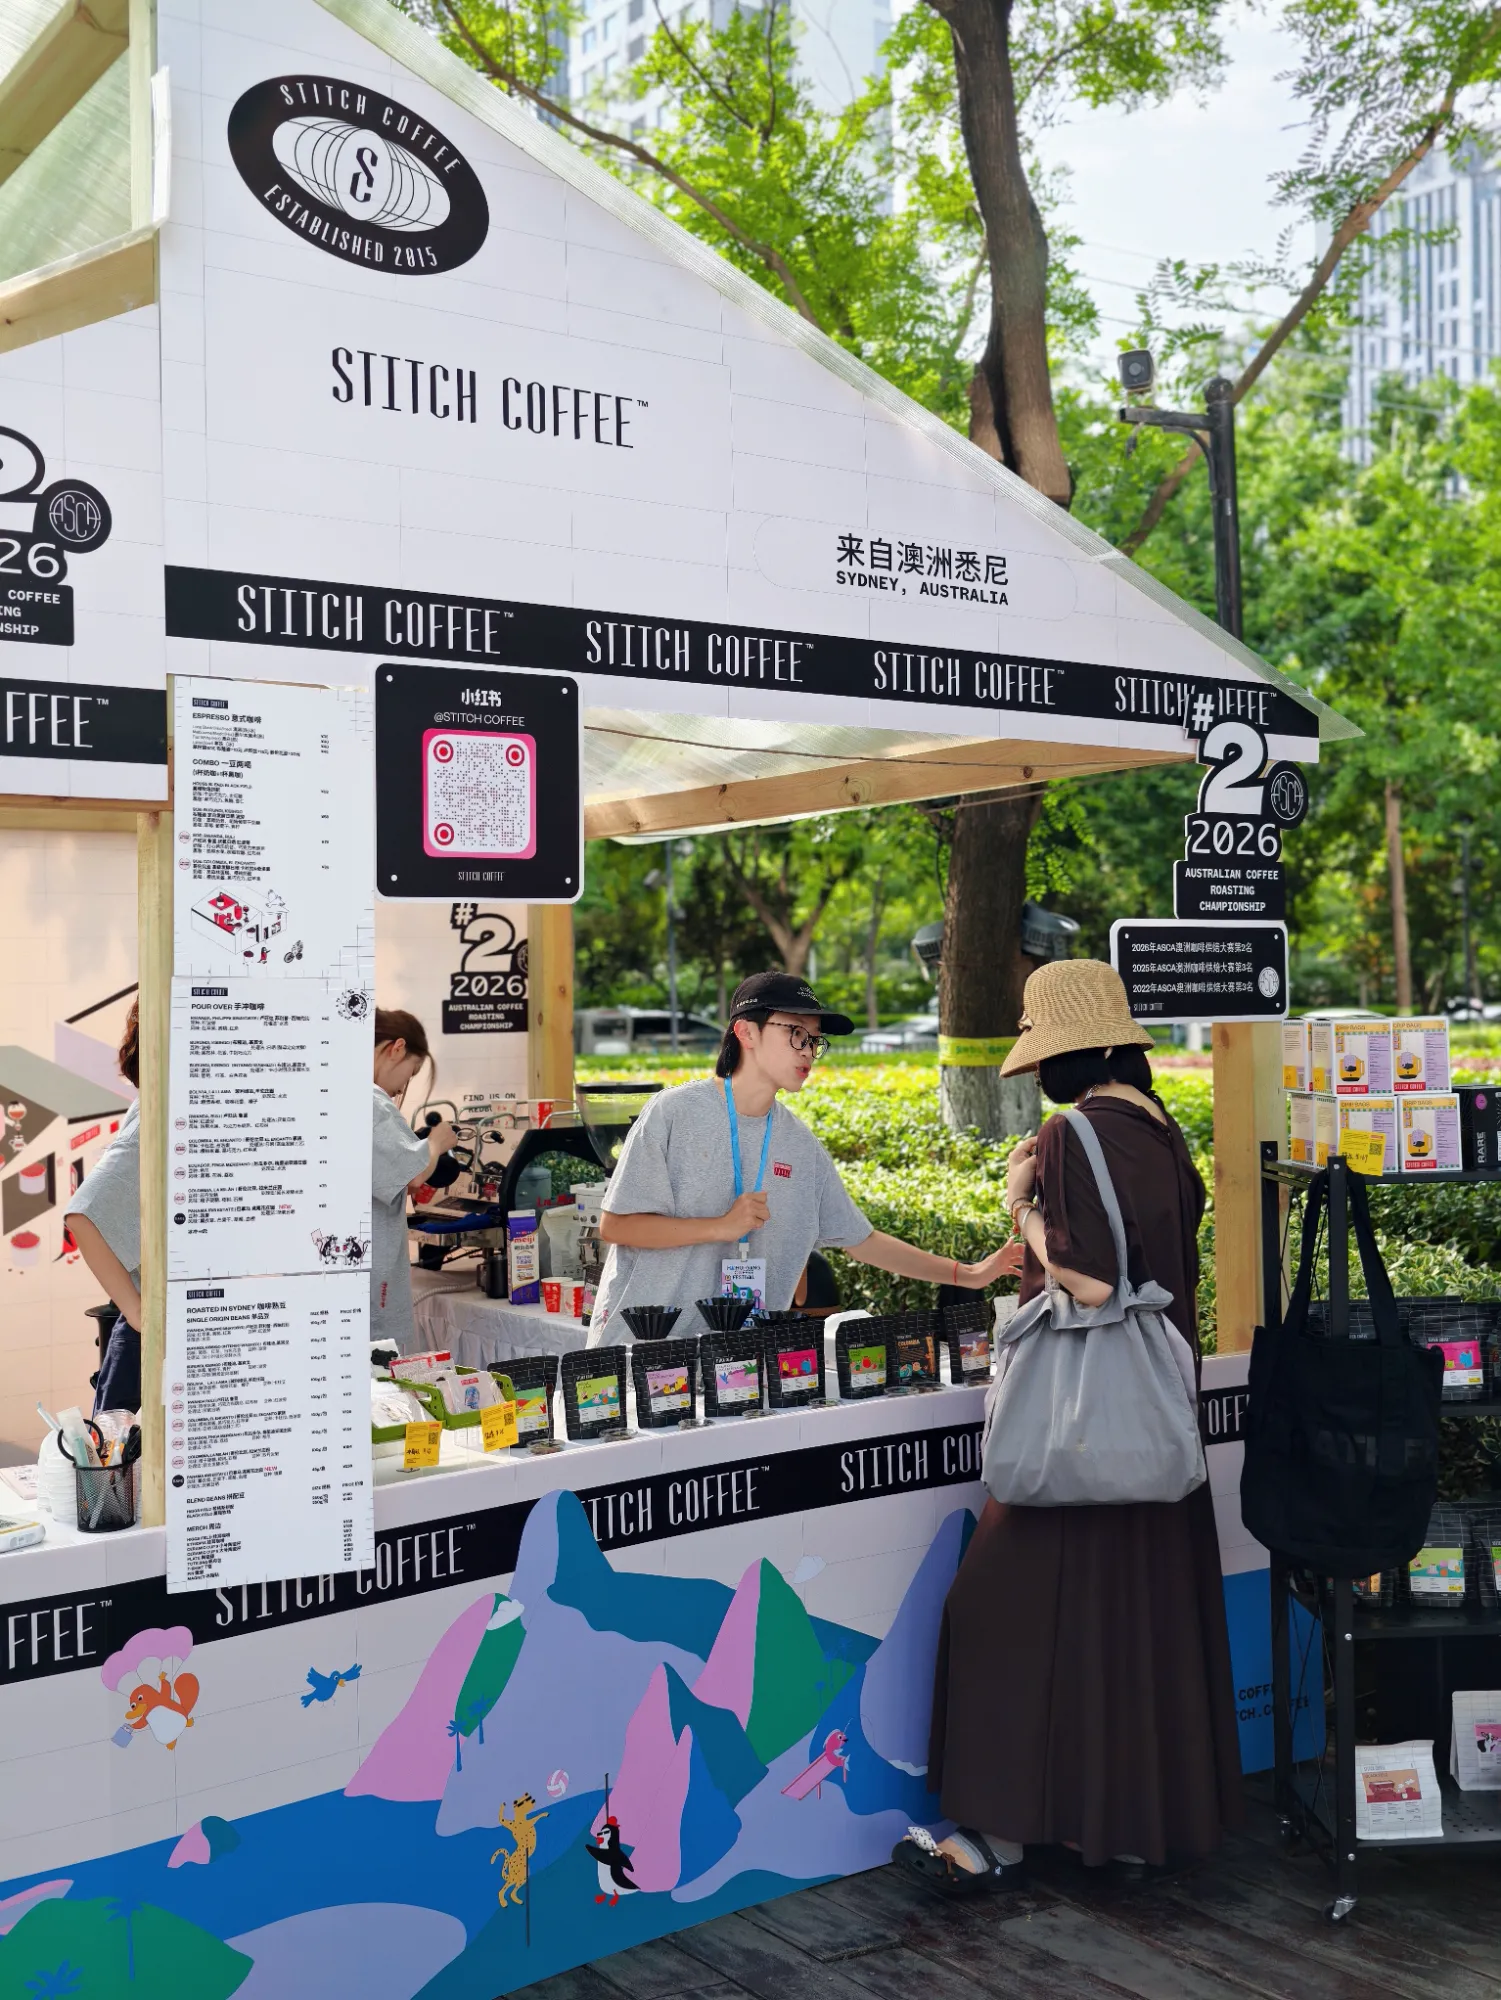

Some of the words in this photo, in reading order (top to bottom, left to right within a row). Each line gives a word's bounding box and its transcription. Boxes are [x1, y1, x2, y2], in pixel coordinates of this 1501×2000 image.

[280, 83, 366, 115] STITCH
[383, 106, 463, 175] COFFEE
[263, 184, 384, 264] ESTABLISHED
[394, 246, 439, 268] 2015
[332, 347, 477, 423] STITCH
[0, 538, 60, 578] 26
[836, 533, 1009, 586] 来自澳洲悉尼
[8, 590, 61, 605] COFFEE
[836, 571, 909, 596] SYDNEY,
[919, 581, 1009, 606] AUSTRALIA
[237, 584, 364, 642] STITCH
[586, 620, 690, 672] STITCH
[874, 650, 960, 697] STITCH
[461, 688, 502, 707] 小红书
[1115, 676, 1188, 717] STITCH
[192, 713, 230, 721] ESPRESSO
[231, 714, 262, 724] 意式咖啡
[434, 711, 482, 724] @STITCH
[483, 715, 525, 727] COFFEE
[1191, 820, 1278, 857] 2026
[1185, 867, 1242, 880] AUSTRALIAN
[1246, 868, 1279, 881] COFFEE
[1210, 885, 1255, 895] ROASTING
[1199, 901, 1266, 912] CHAMPIONSHIP
[454, 975, 524, 997] 2026
[234, 1002, 265, 1011] 手冲咖啡
[449, 1003, 494, 1012] AUSTRALIAN
[497, 1002, 524, 1011] COFFEE
[468, 1013, 505, 1021] ROASTING
[460, 1021, 514, 1031] CHAMPIONSHIP
[463, 1094, 485, 1102] FIND
[1477, 1132, 1486, 1163] RARE
[514, 1235, 535, 1244] meiji
[187, 1306, 220, 1314] ROASTED
[1202, 1394, 1250, 1435] OFF
[840, 1438, 929, 1493] STITCH
[943, 1432, 983, 1475] COF
[581, 1488, 652, 1541] ITCH
